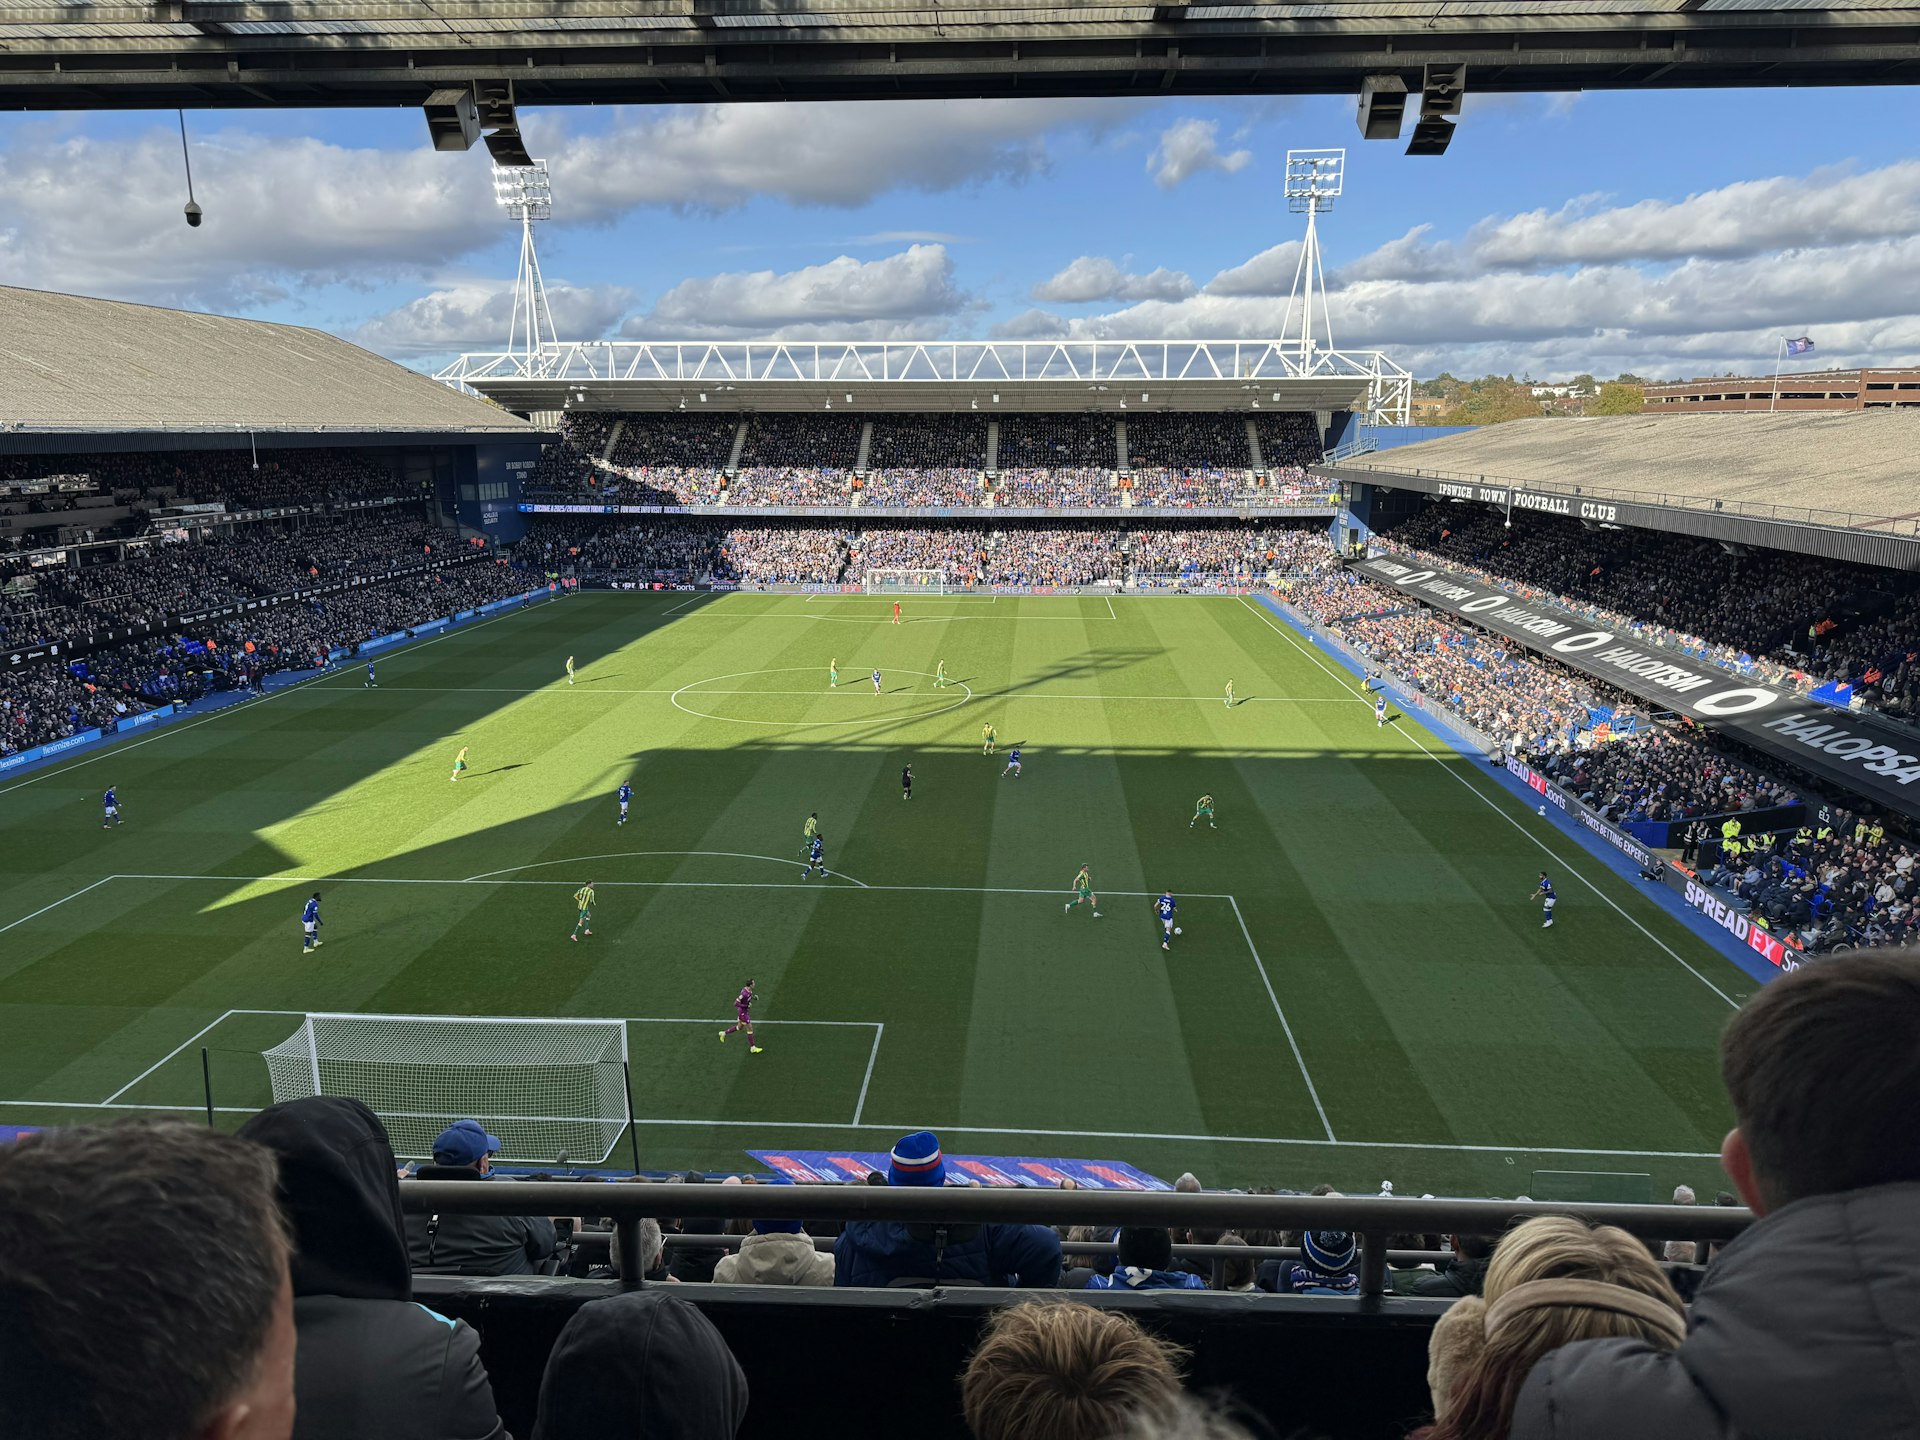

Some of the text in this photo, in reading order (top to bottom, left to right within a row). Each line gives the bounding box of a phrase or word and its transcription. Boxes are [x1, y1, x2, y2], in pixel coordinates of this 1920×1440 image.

[1438, 483, 1616, 521] IPSWICH TOWN FOOTBALL CLUB
[801, 584, 841, 592] SPREAD
[1419, 579, 1476, 601] HALOPSA
[1489, 606, 1572, 638] HALOCRM
[1593, 646, 1712, 692] HALOITSM
[42, 736, 86, 754] fleximize.com
[1761, 714, 1920, 785] HALOPSA
[1545, 782, 1566, 810] Sports
[1818, 810, 1830, 823] EL2
[1600, 824, 1623, 848] BETTING
[1624, 841, 1649, 866] EXPERTS
[1161, 902, 1171, 912] 26
[1685, 880, 1749, 941] SPREAD
[1751, 926, 1776, 960] EX
